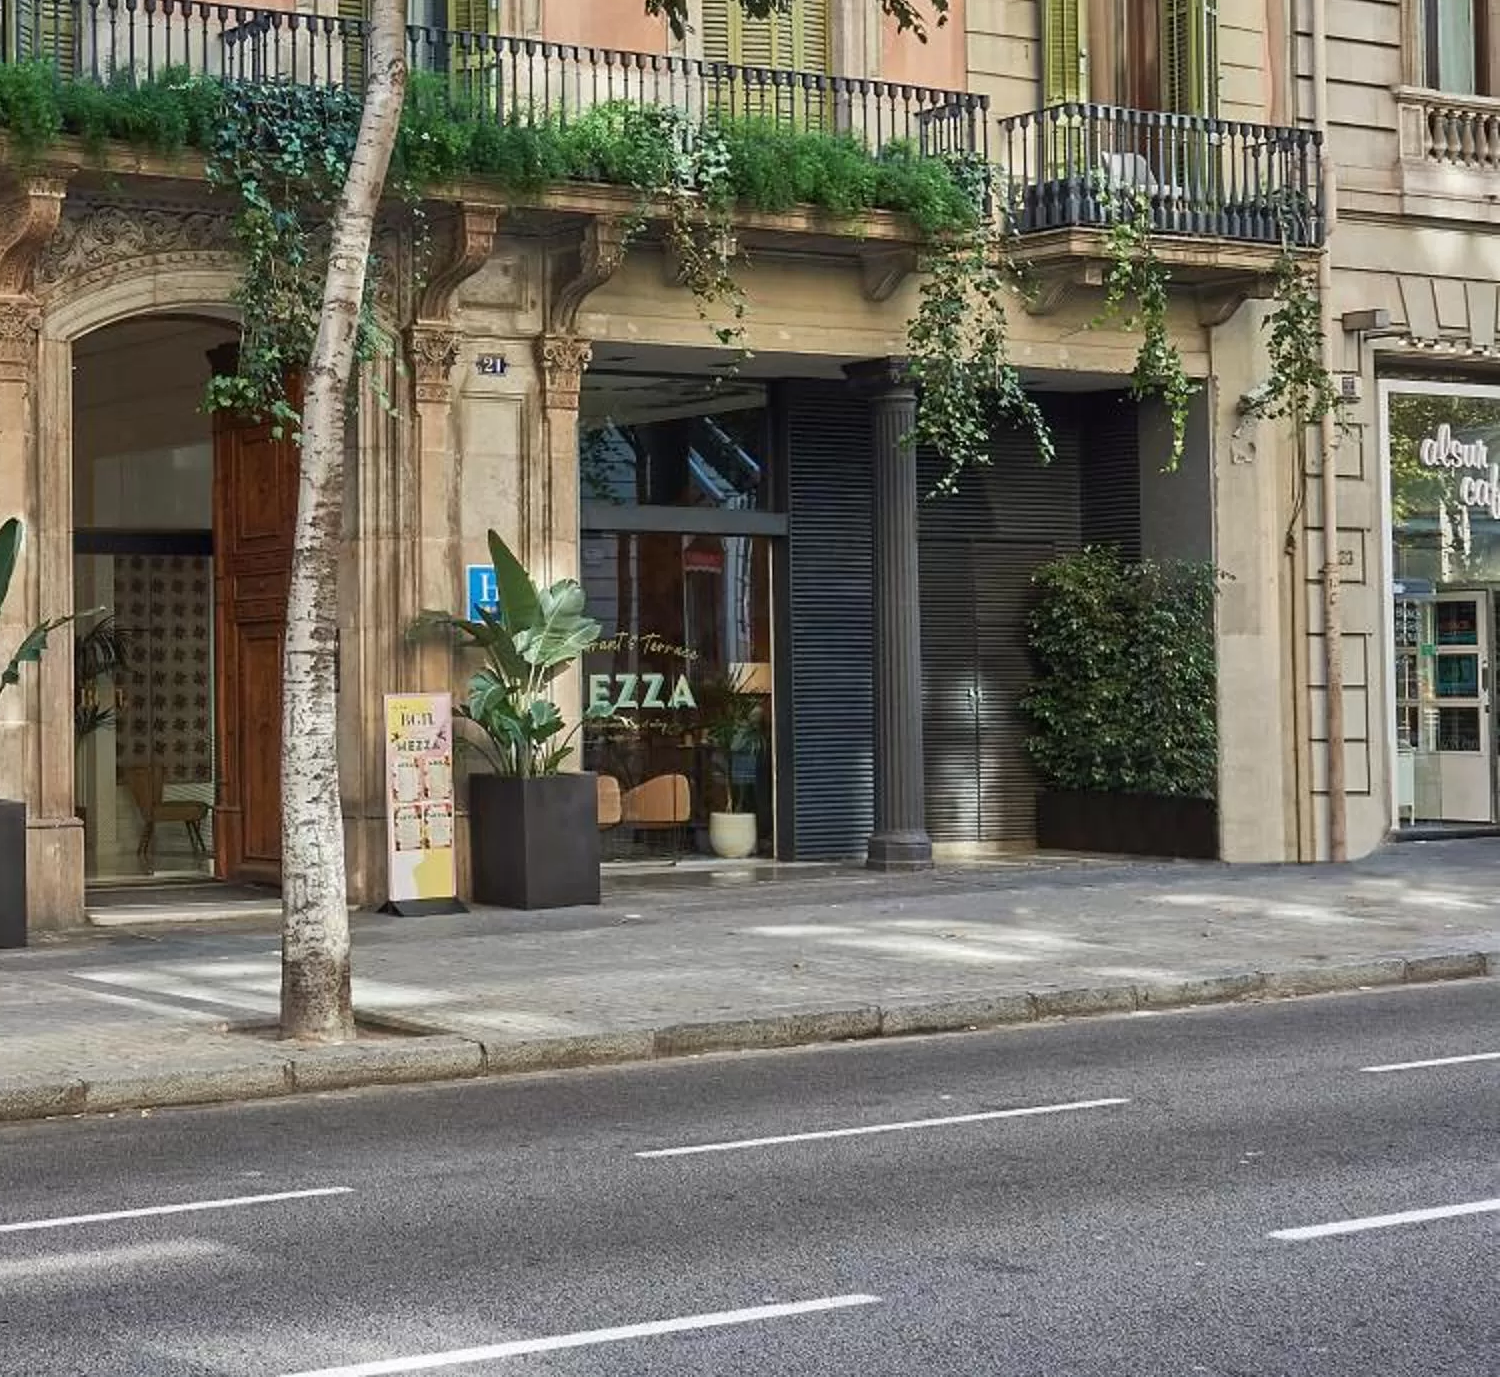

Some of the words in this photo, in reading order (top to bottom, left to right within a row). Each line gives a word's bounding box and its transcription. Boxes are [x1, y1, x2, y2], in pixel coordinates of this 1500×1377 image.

[483, 356, 501, 373] 21
[1420, 423, 1489, 469] alsur
[589, 673, 698, 711] EZZA
